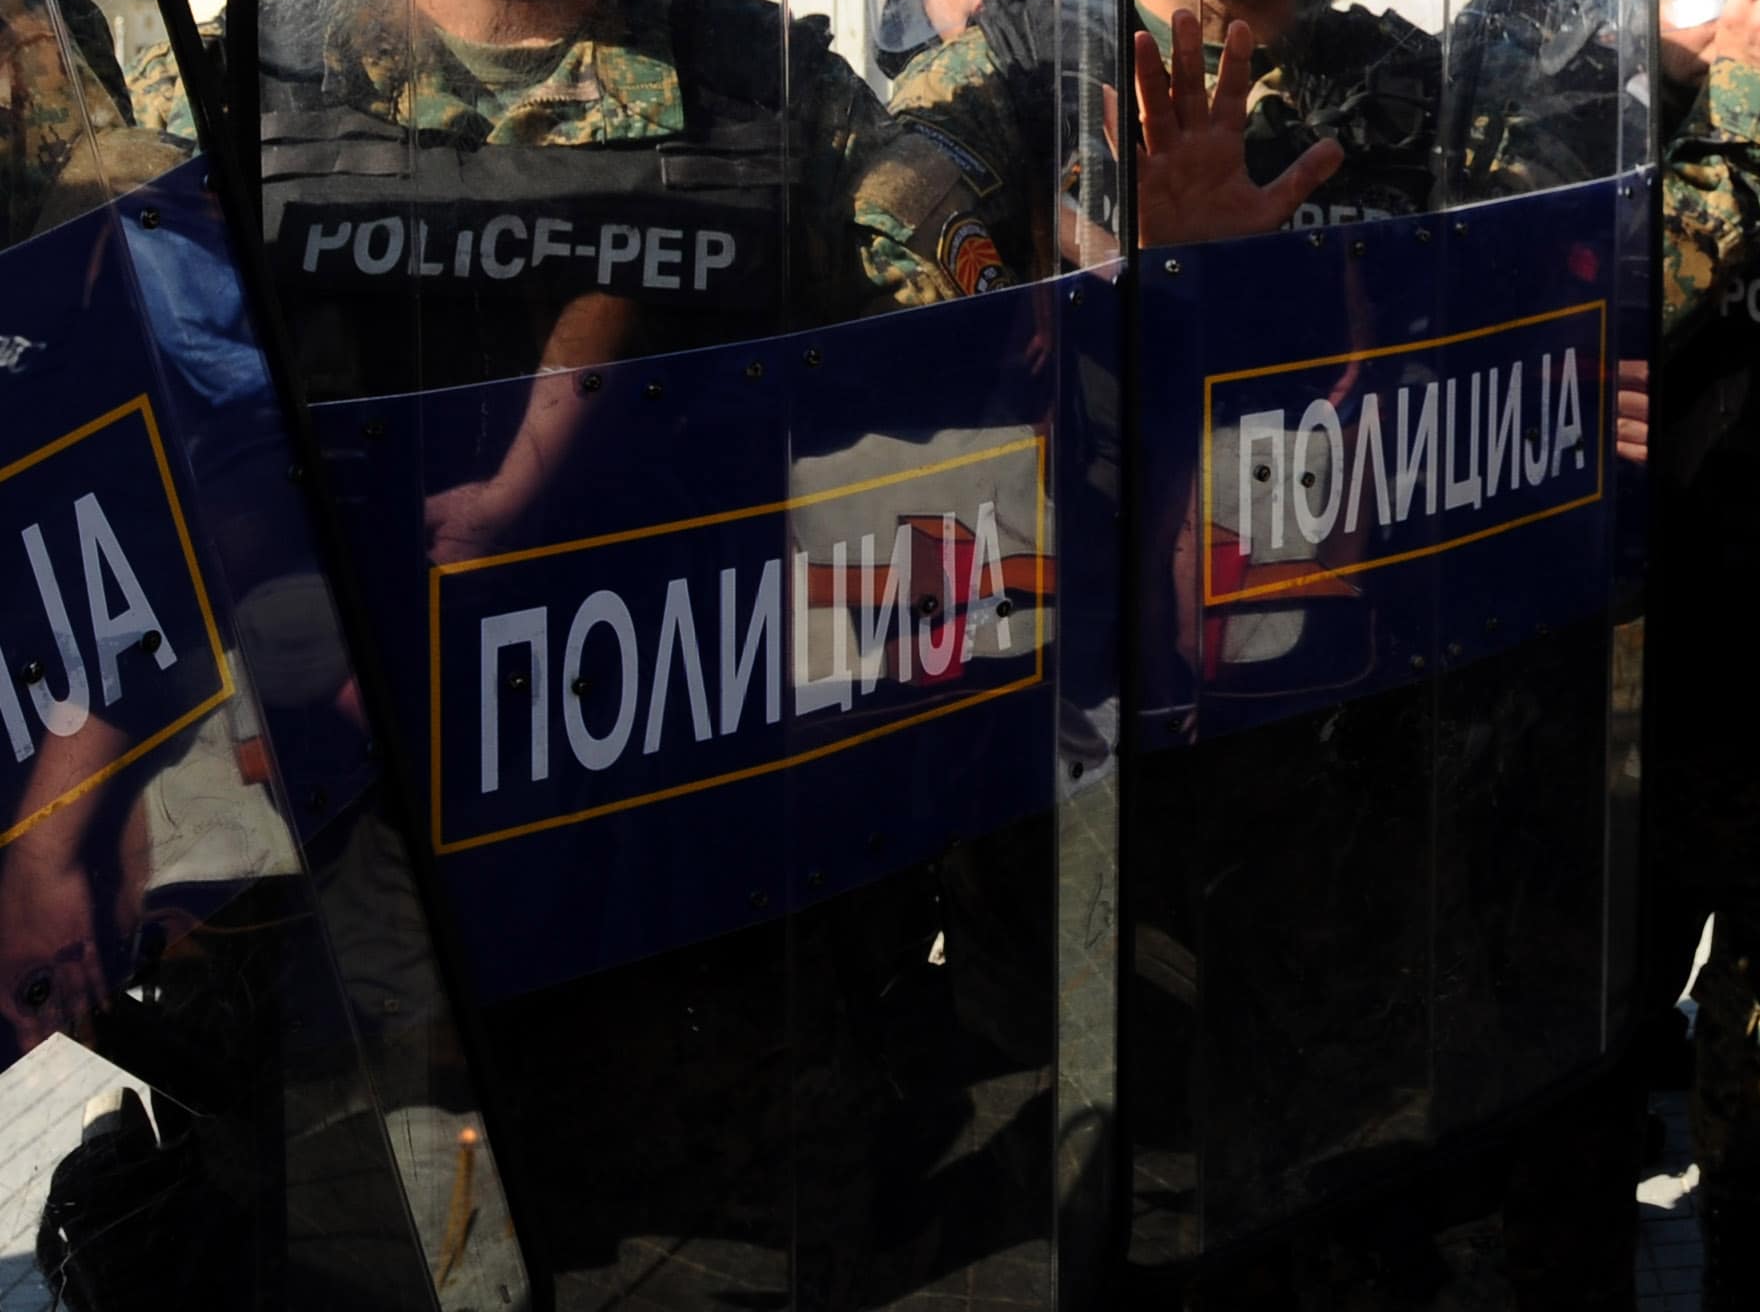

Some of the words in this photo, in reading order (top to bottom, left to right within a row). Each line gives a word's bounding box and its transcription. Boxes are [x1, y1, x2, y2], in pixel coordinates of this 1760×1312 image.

[301, 213, 737, 291] POLICE-PEP
[1238, 347, 1585, 556] ПОЛИЦИЈА
[480, 501, 1012, 793] ПОЛИЦИЈА
